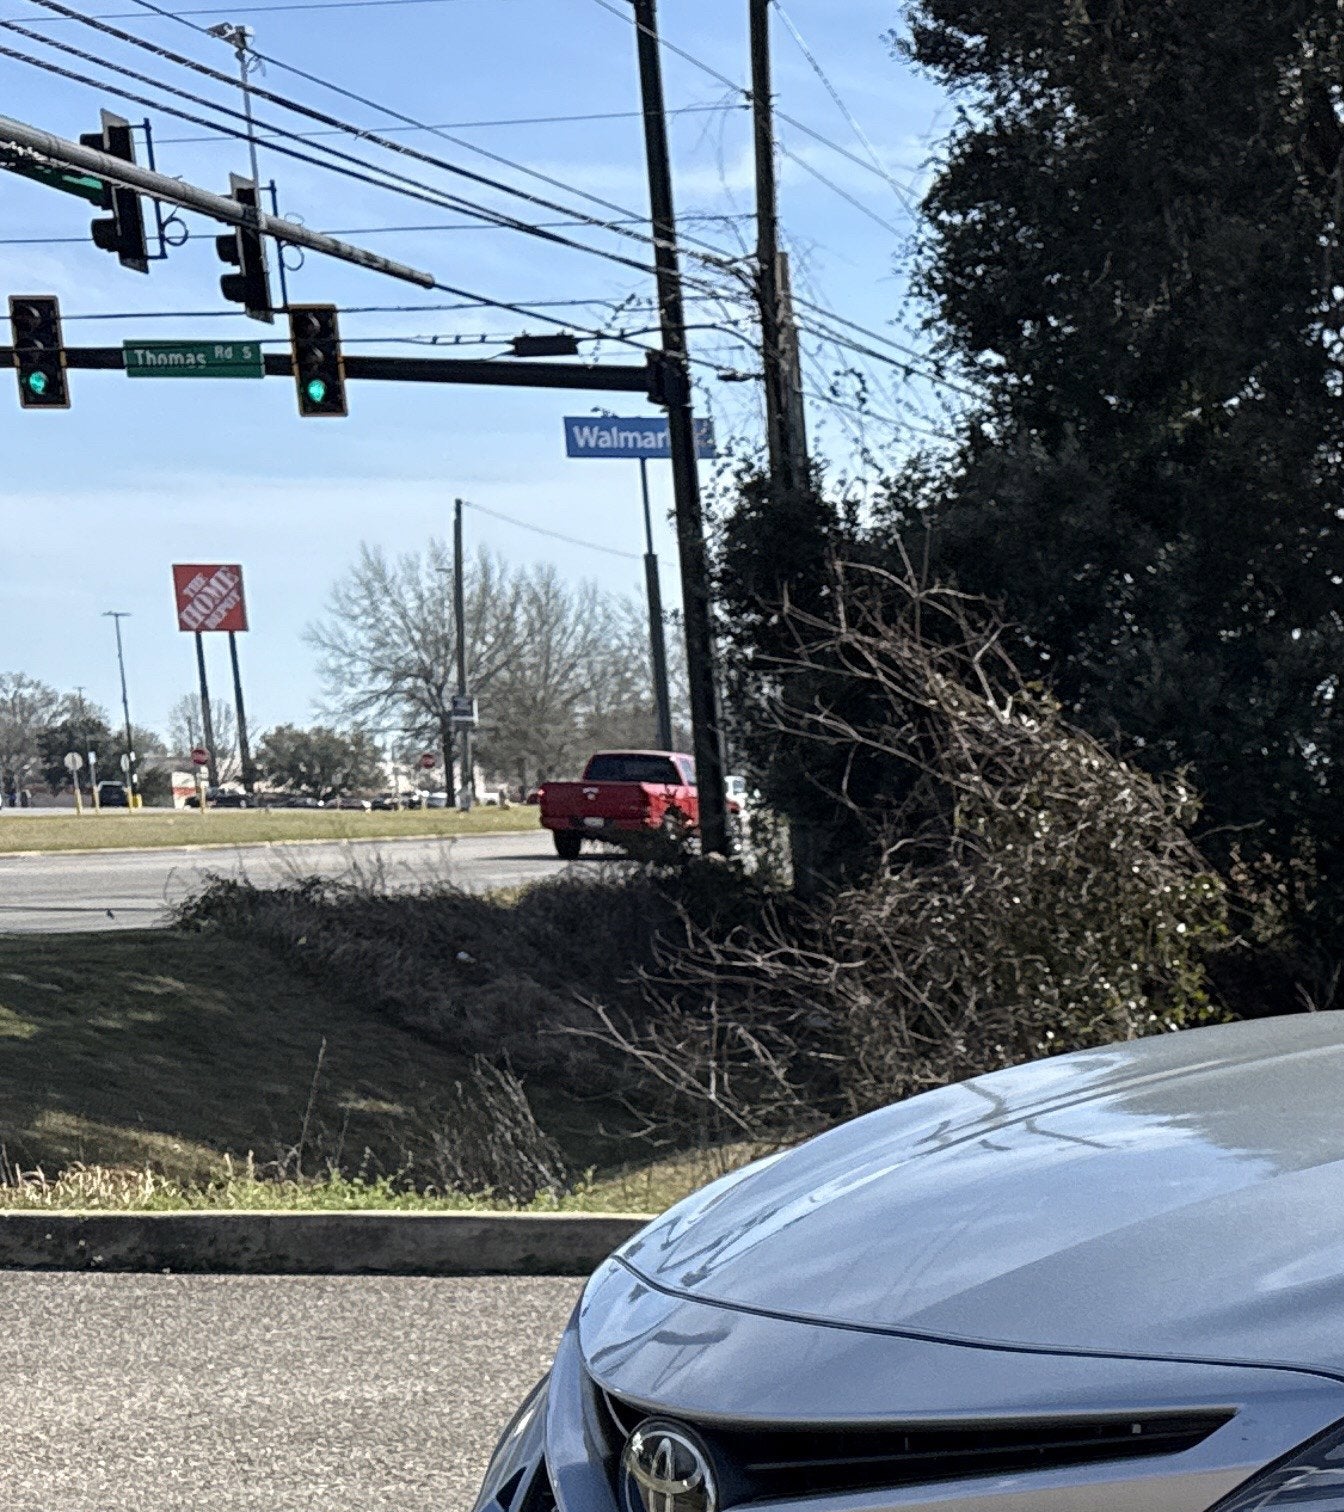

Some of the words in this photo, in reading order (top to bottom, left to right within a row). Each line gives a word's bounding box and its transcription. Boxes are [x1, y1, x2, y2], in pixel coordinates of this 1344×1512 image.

[134, 349, 207, 369] Thomas
[214, 344, 233, 360] Rd
[241, 345, 252, 359] S
[180, 566, 240, 629] HOME
